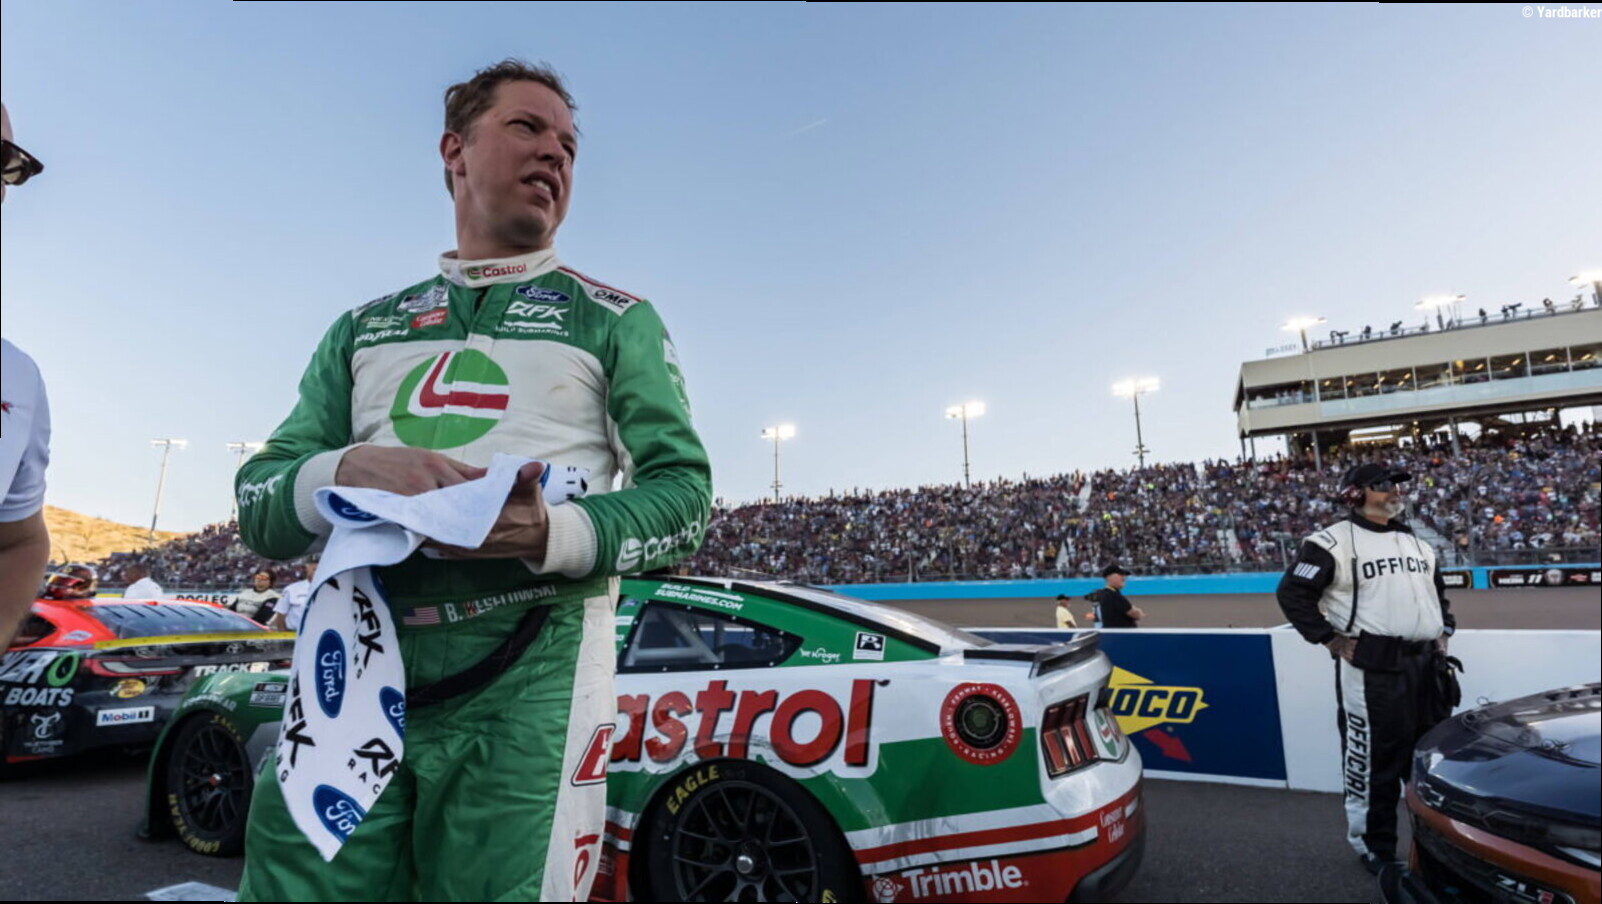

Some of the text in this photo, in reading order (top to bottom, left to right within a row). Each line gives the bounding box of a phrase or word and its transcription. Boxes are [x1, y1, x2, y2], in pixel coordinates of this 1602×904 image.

[483, 263, 527, 277] Castrol
[525, 286, 561, 301] Ford
[505, 301, 569, 320] RFK
[660, 583, 691, 592] BUILD
[654, 588, 744, 611] SUBMARINES.COM
[320, 650, 344, 702] Ford
[5, 687, 74, 706] BOATS
[1106, 688, 1199, 719] OCO
[101, 712, 137, 723] Mobil
[612, 679, 876, 768] astrol
[1346, 712, 1367, 801] OFFICIAL
[666, 765, 720, 815] EAGLE
[902, 859, 1023, 898] Trimble
